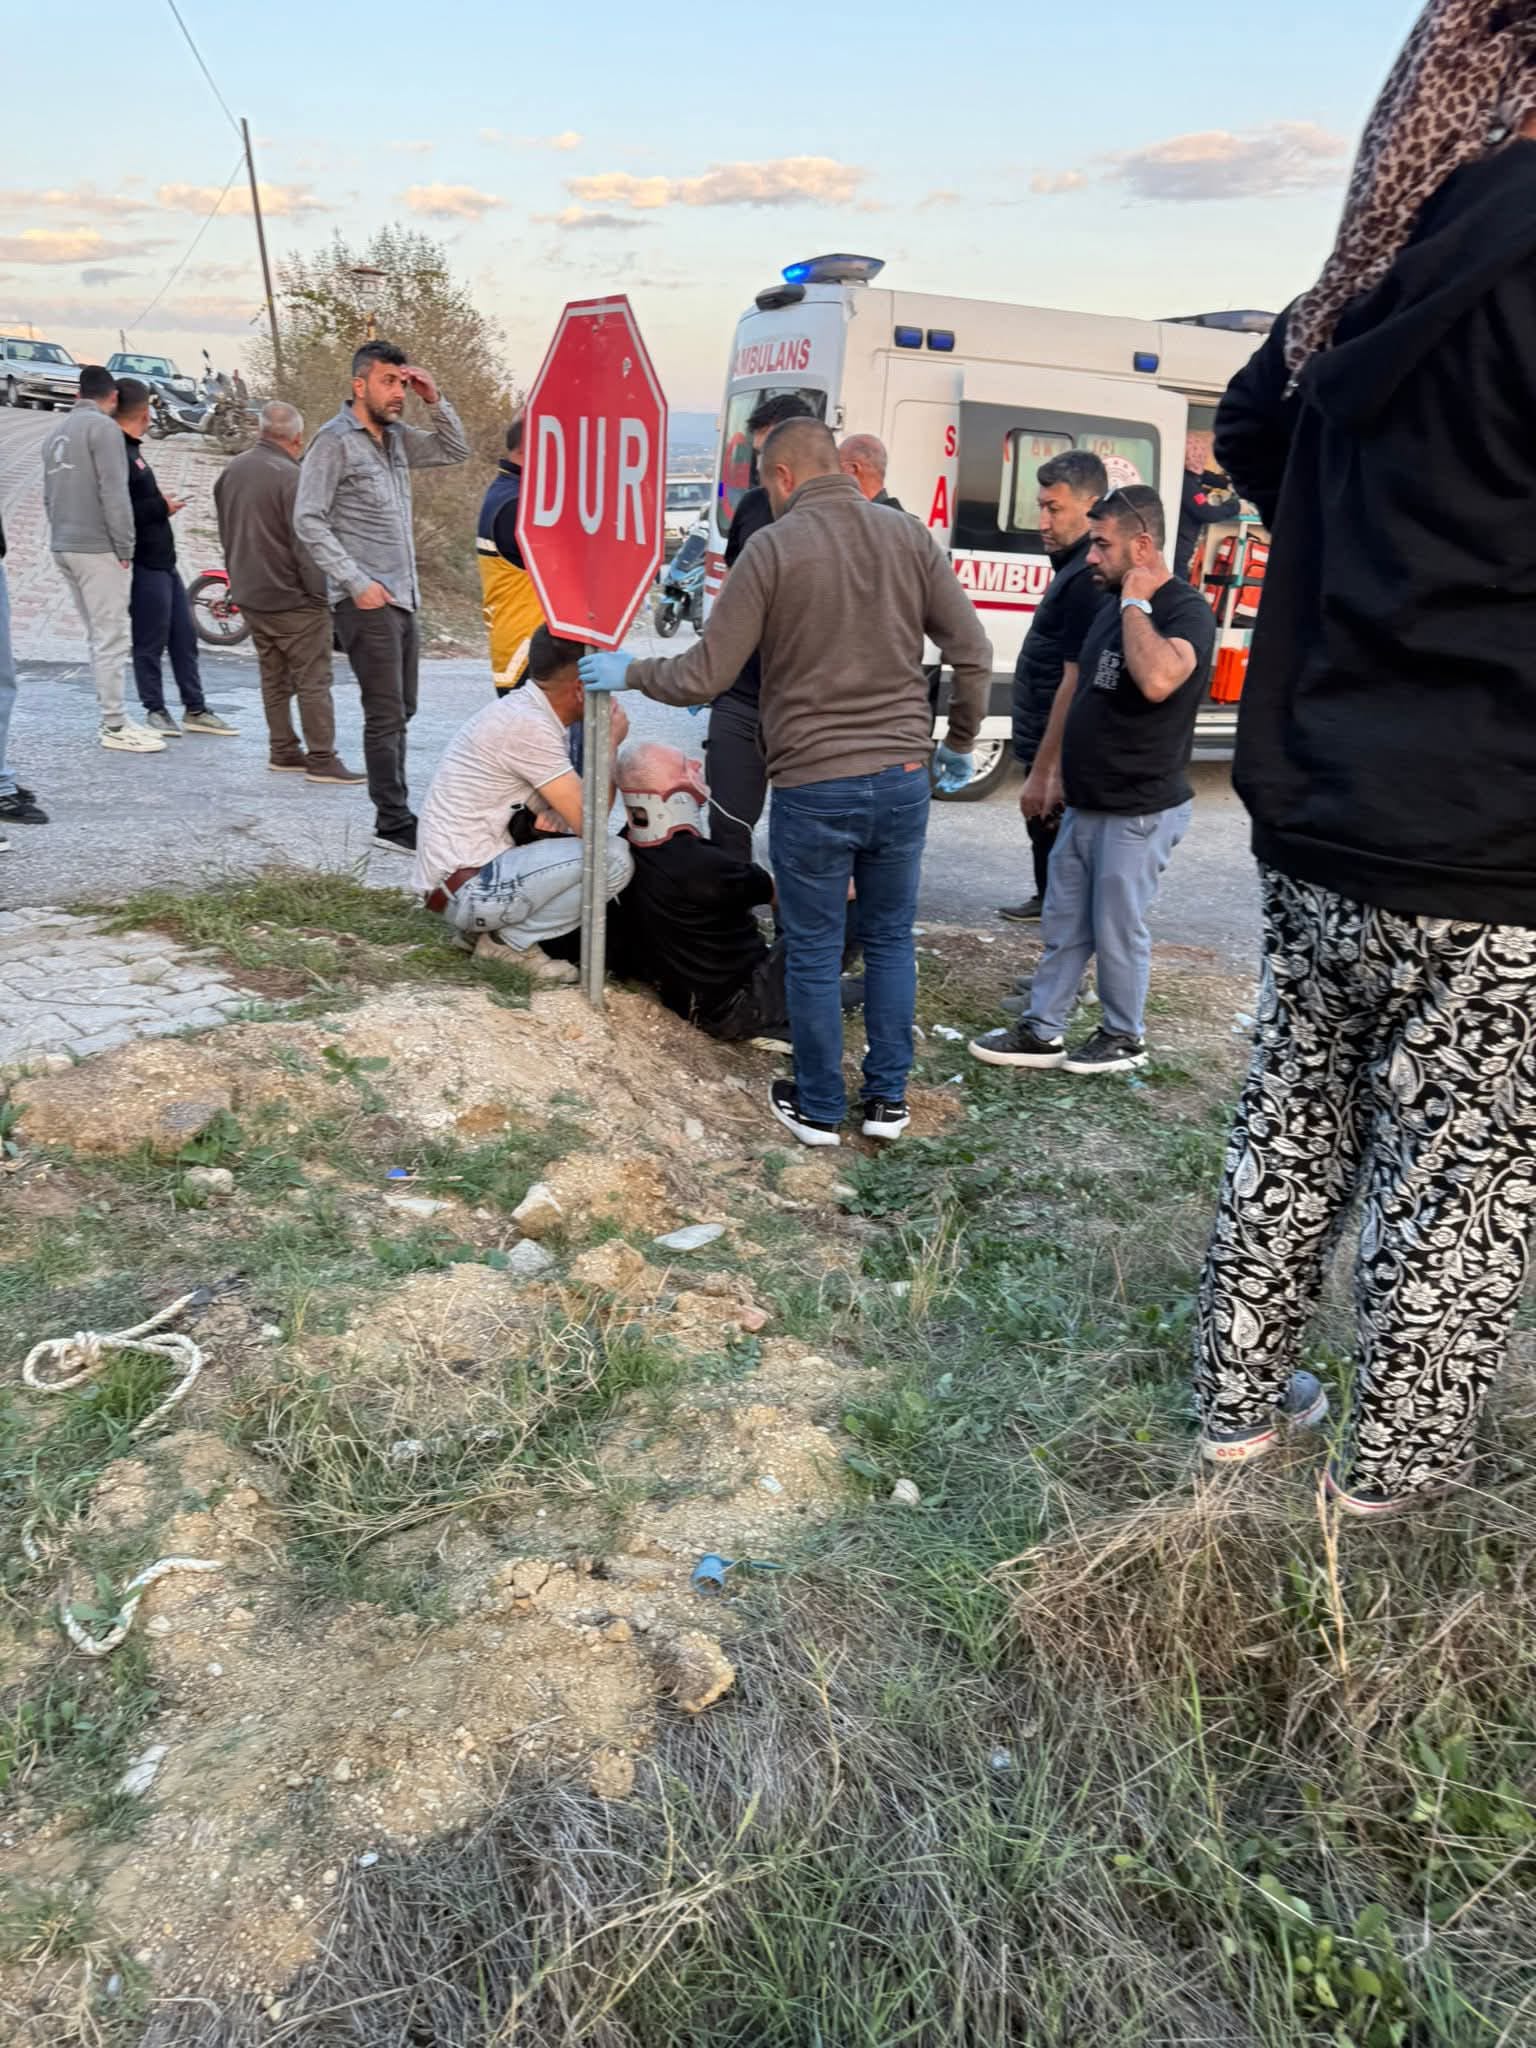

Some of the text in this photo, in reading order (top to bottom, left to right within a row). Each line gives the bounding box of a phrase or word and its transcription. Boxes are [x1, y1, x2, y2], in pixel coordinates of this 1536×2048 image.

[732, 338, 812, 376] AMBULANS
[533, 415, 649, 545] DUR
[956, 559, 1056, 594] AMBU
